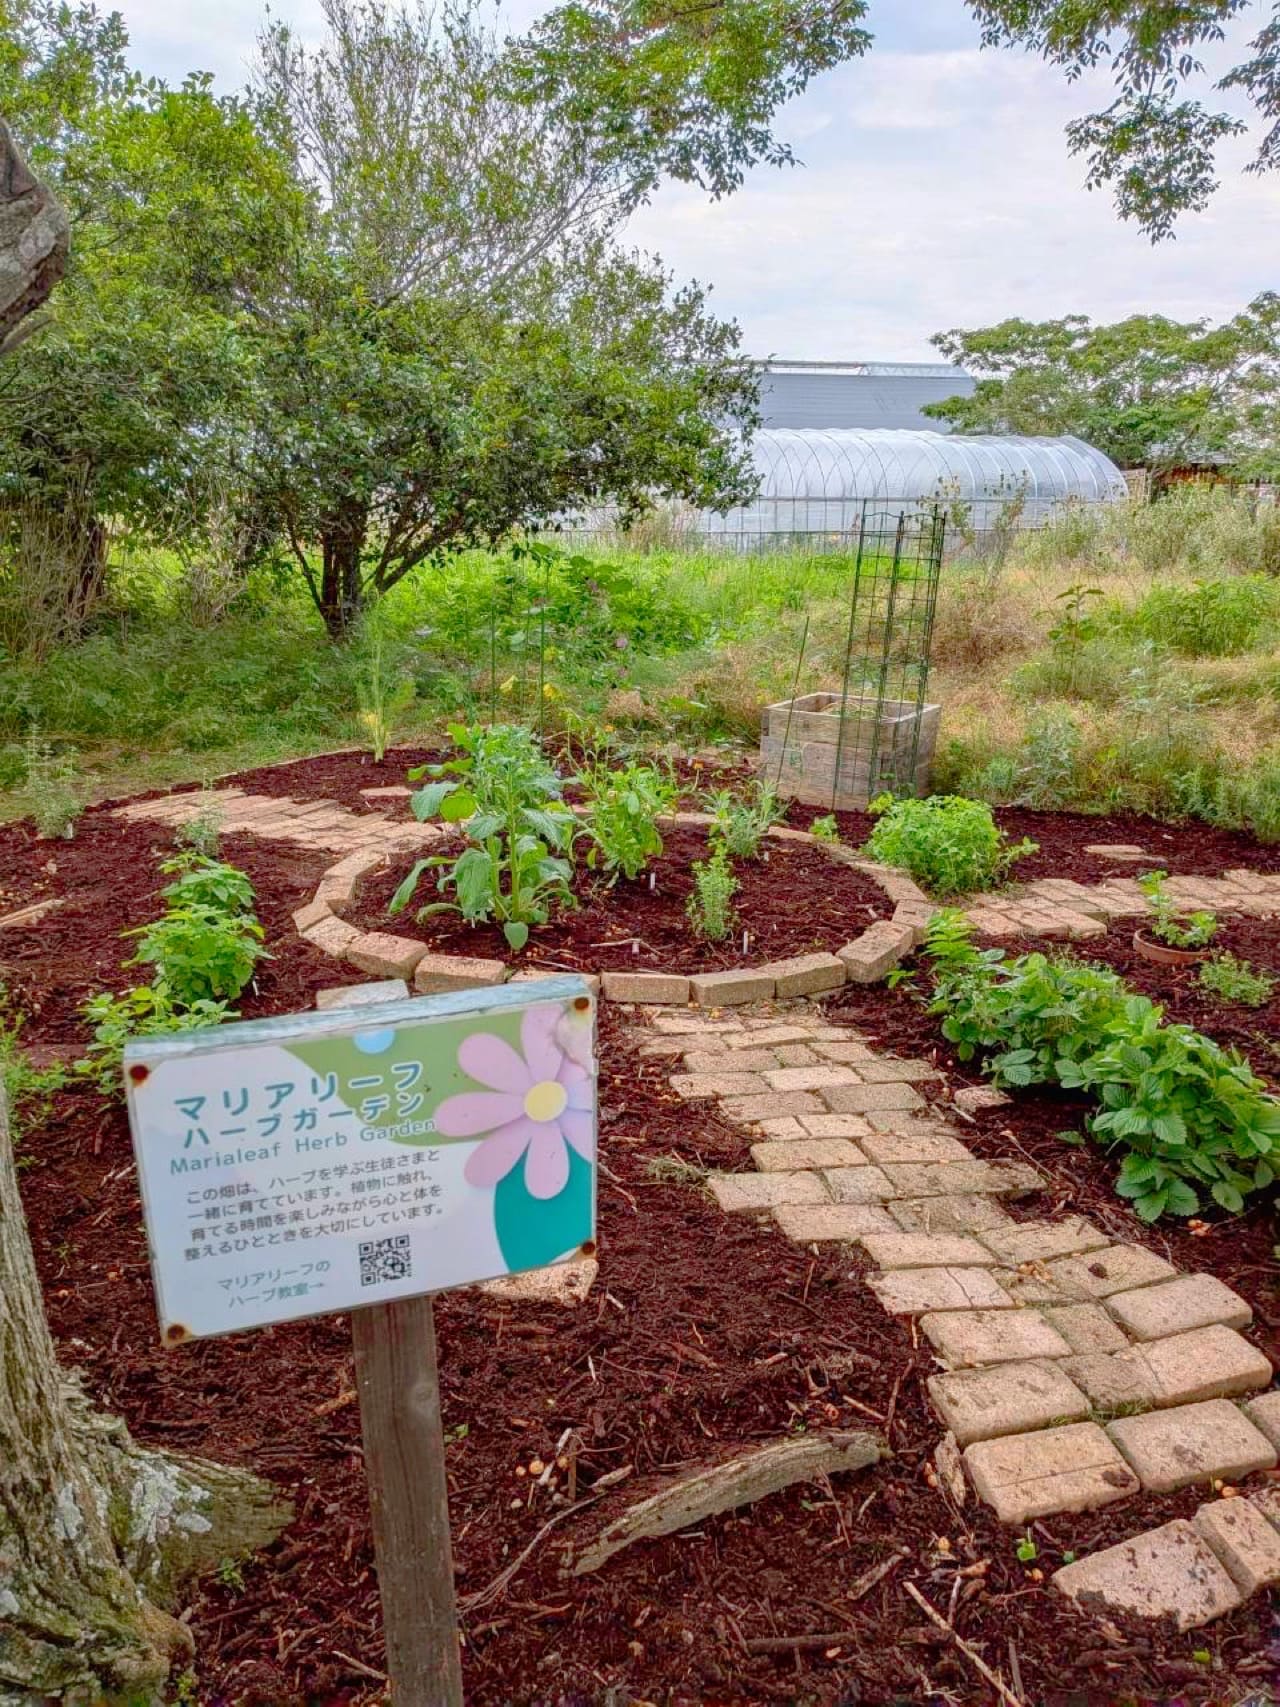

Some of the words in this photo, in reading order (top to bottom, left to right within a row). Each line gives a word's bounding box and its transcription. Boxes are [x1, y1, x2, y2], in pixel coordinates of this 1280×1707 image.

[174, 1063, 421, 1120] マリアリーフ
[170, 1143, 281, 1175] Marialeaf
[295, 1131, 348, 1152] Herb
[360, 1119, 435, 1142] Garden
[184, 1094, 421, 1148] ハーブガーデン
[218, 1261, 331, 1290] マリアリーフの
